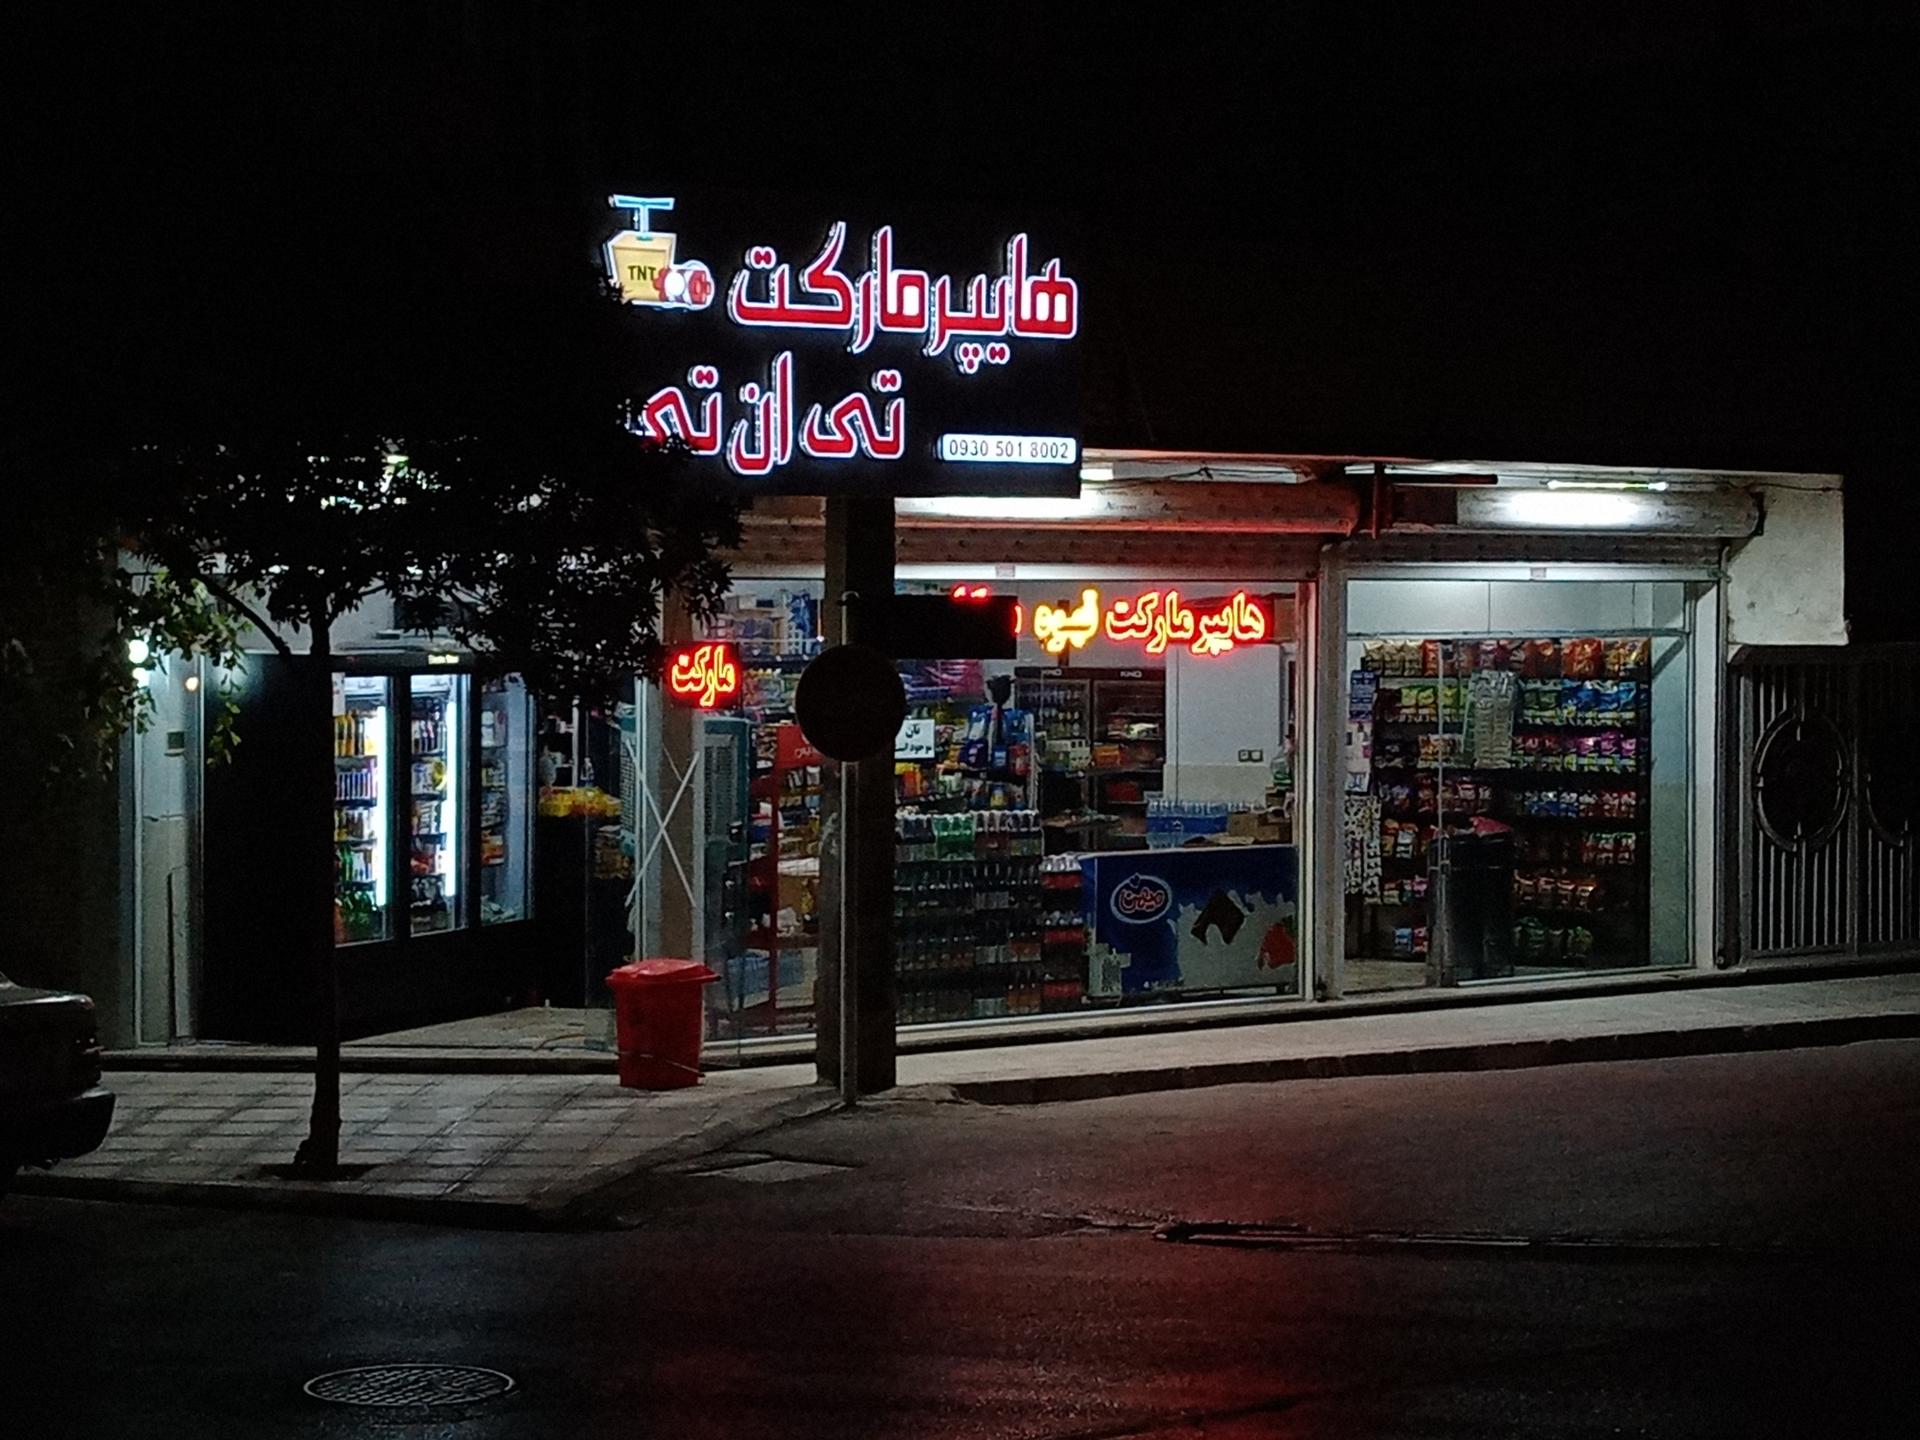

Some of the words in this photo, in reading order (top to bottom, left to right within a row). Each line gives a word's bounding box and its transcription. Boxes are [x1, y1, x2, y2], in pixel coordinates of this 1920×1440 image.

[627, 265, 657, 281] TNT
[726, 221, 1078, 374] هایپرمارکت
[727, 351, 793, 475] ان
[800, 369, 906, 460] تی
[949, 439, 989, 457] 0930
[995, 441, 1023, 457] 501
[1030, 442, 1069, 459] 8002
[671, 645, 736, 707] مارکت
[1119, 886, 1166, 914] میهن
